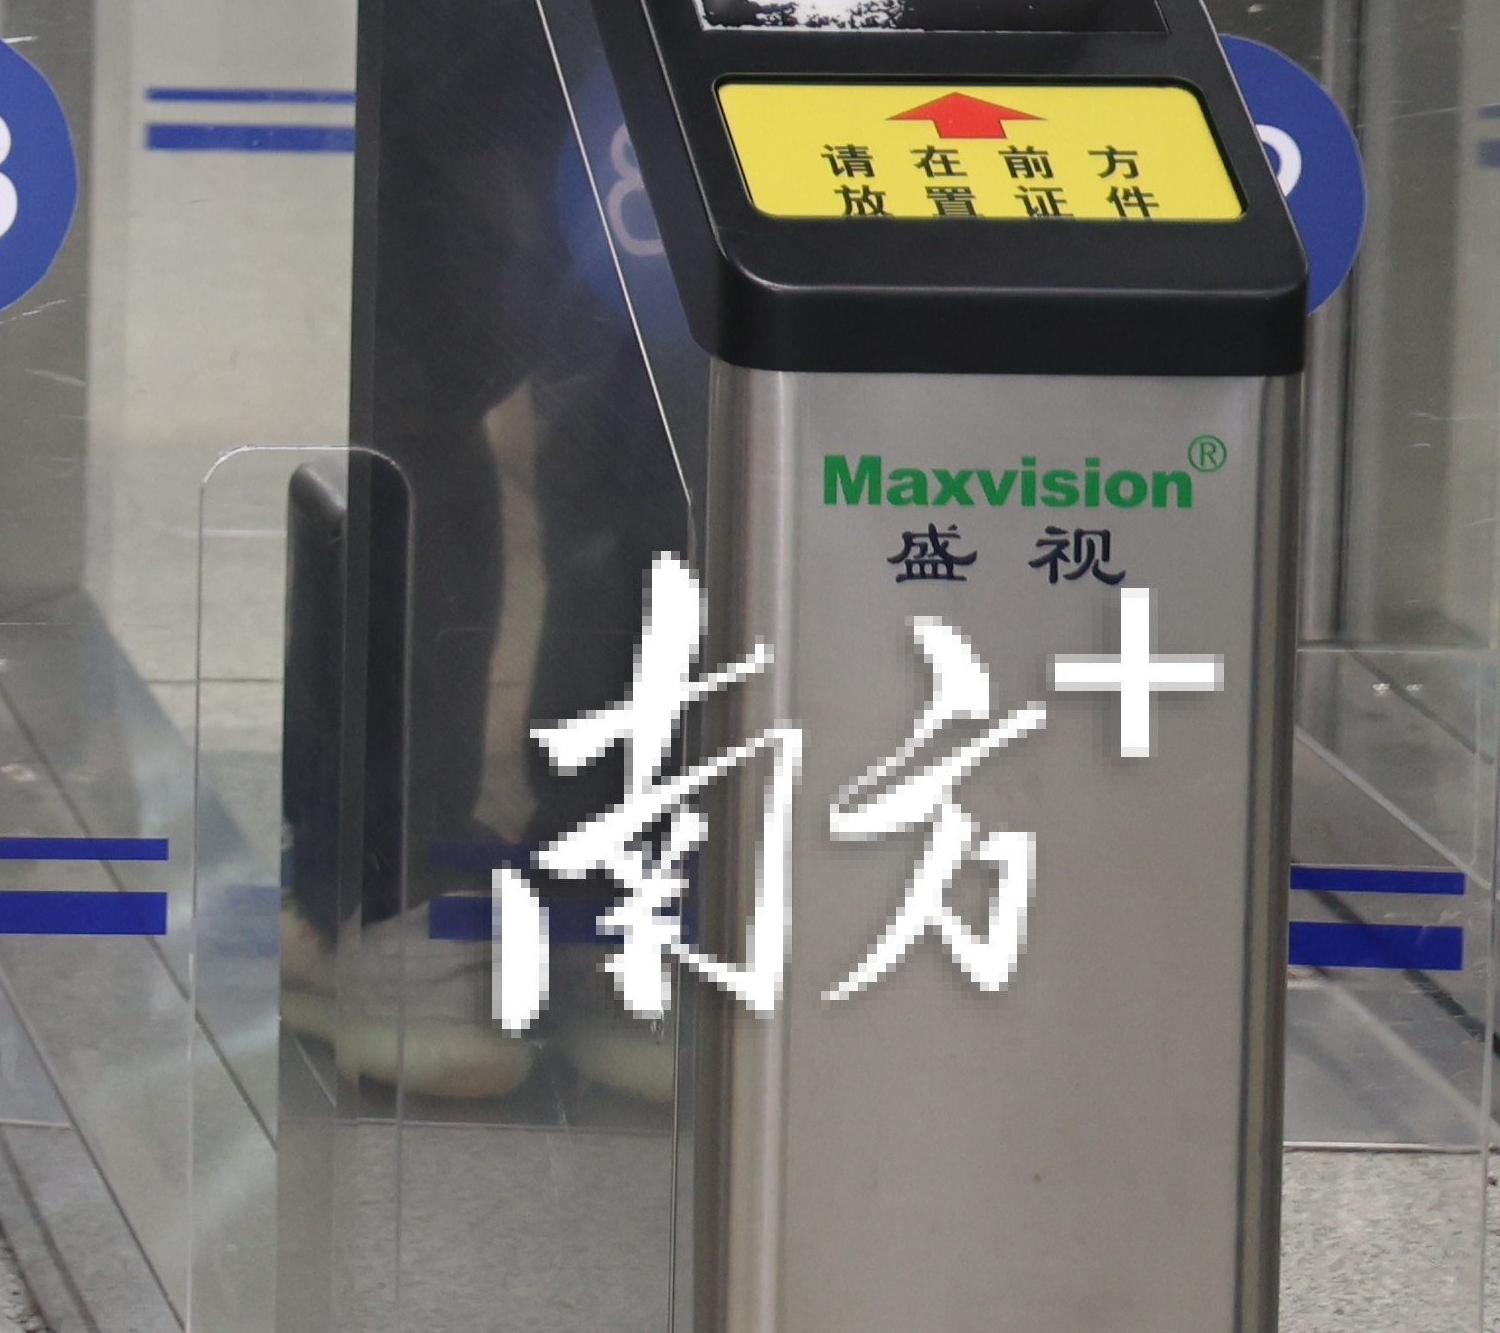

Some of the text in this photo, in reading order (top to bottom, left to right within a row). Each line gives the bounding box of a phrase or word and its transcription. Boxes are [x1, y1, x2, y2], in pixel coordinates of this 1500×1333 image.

[821, 145, 1138, 179] 请在前方
[833, 184, 1159, 219] 放置证件
[886, 523, 1126, 585] 盛视
